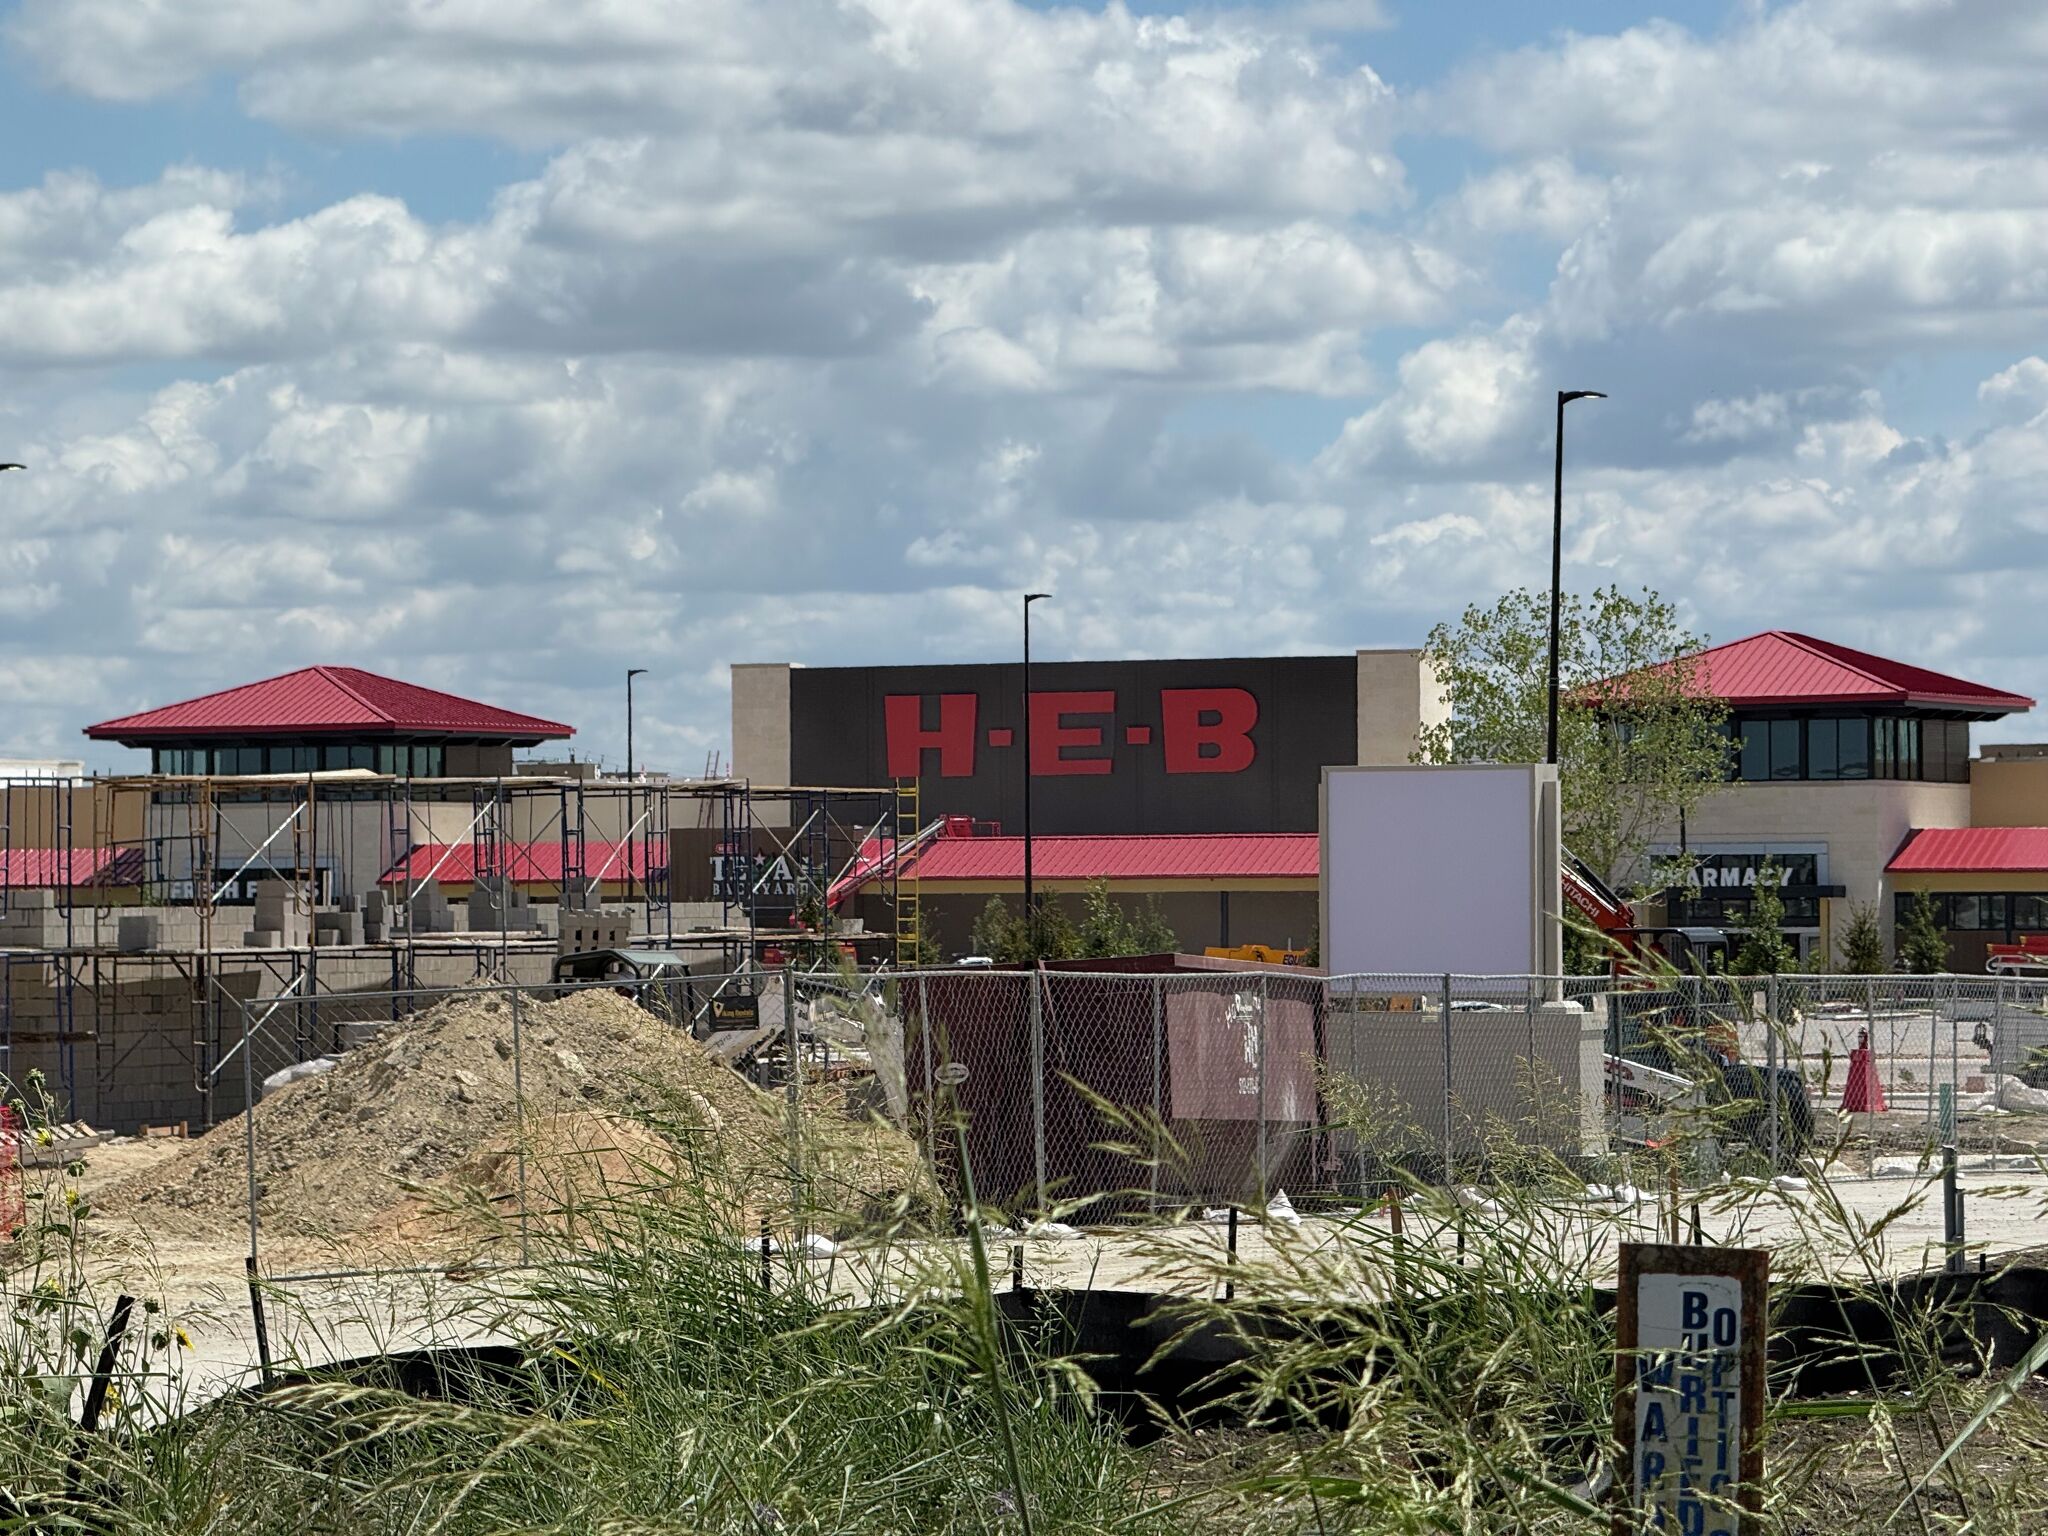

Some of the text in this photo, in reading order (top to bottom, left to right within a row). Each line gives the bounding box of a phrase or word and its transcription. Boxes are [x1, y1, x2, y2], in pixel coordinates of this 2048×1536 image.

[884, 687, 1258, 778] H-E-B
[713, 883, 809, 896] BACYARD
[1562, 879, 1600, 917] HITACHI
[1650, 867, 1793, 887] PARMACY
[1639, 1353, 1674, 1535] WAR
[1678, 1291, 1708, 1535] BURIED
